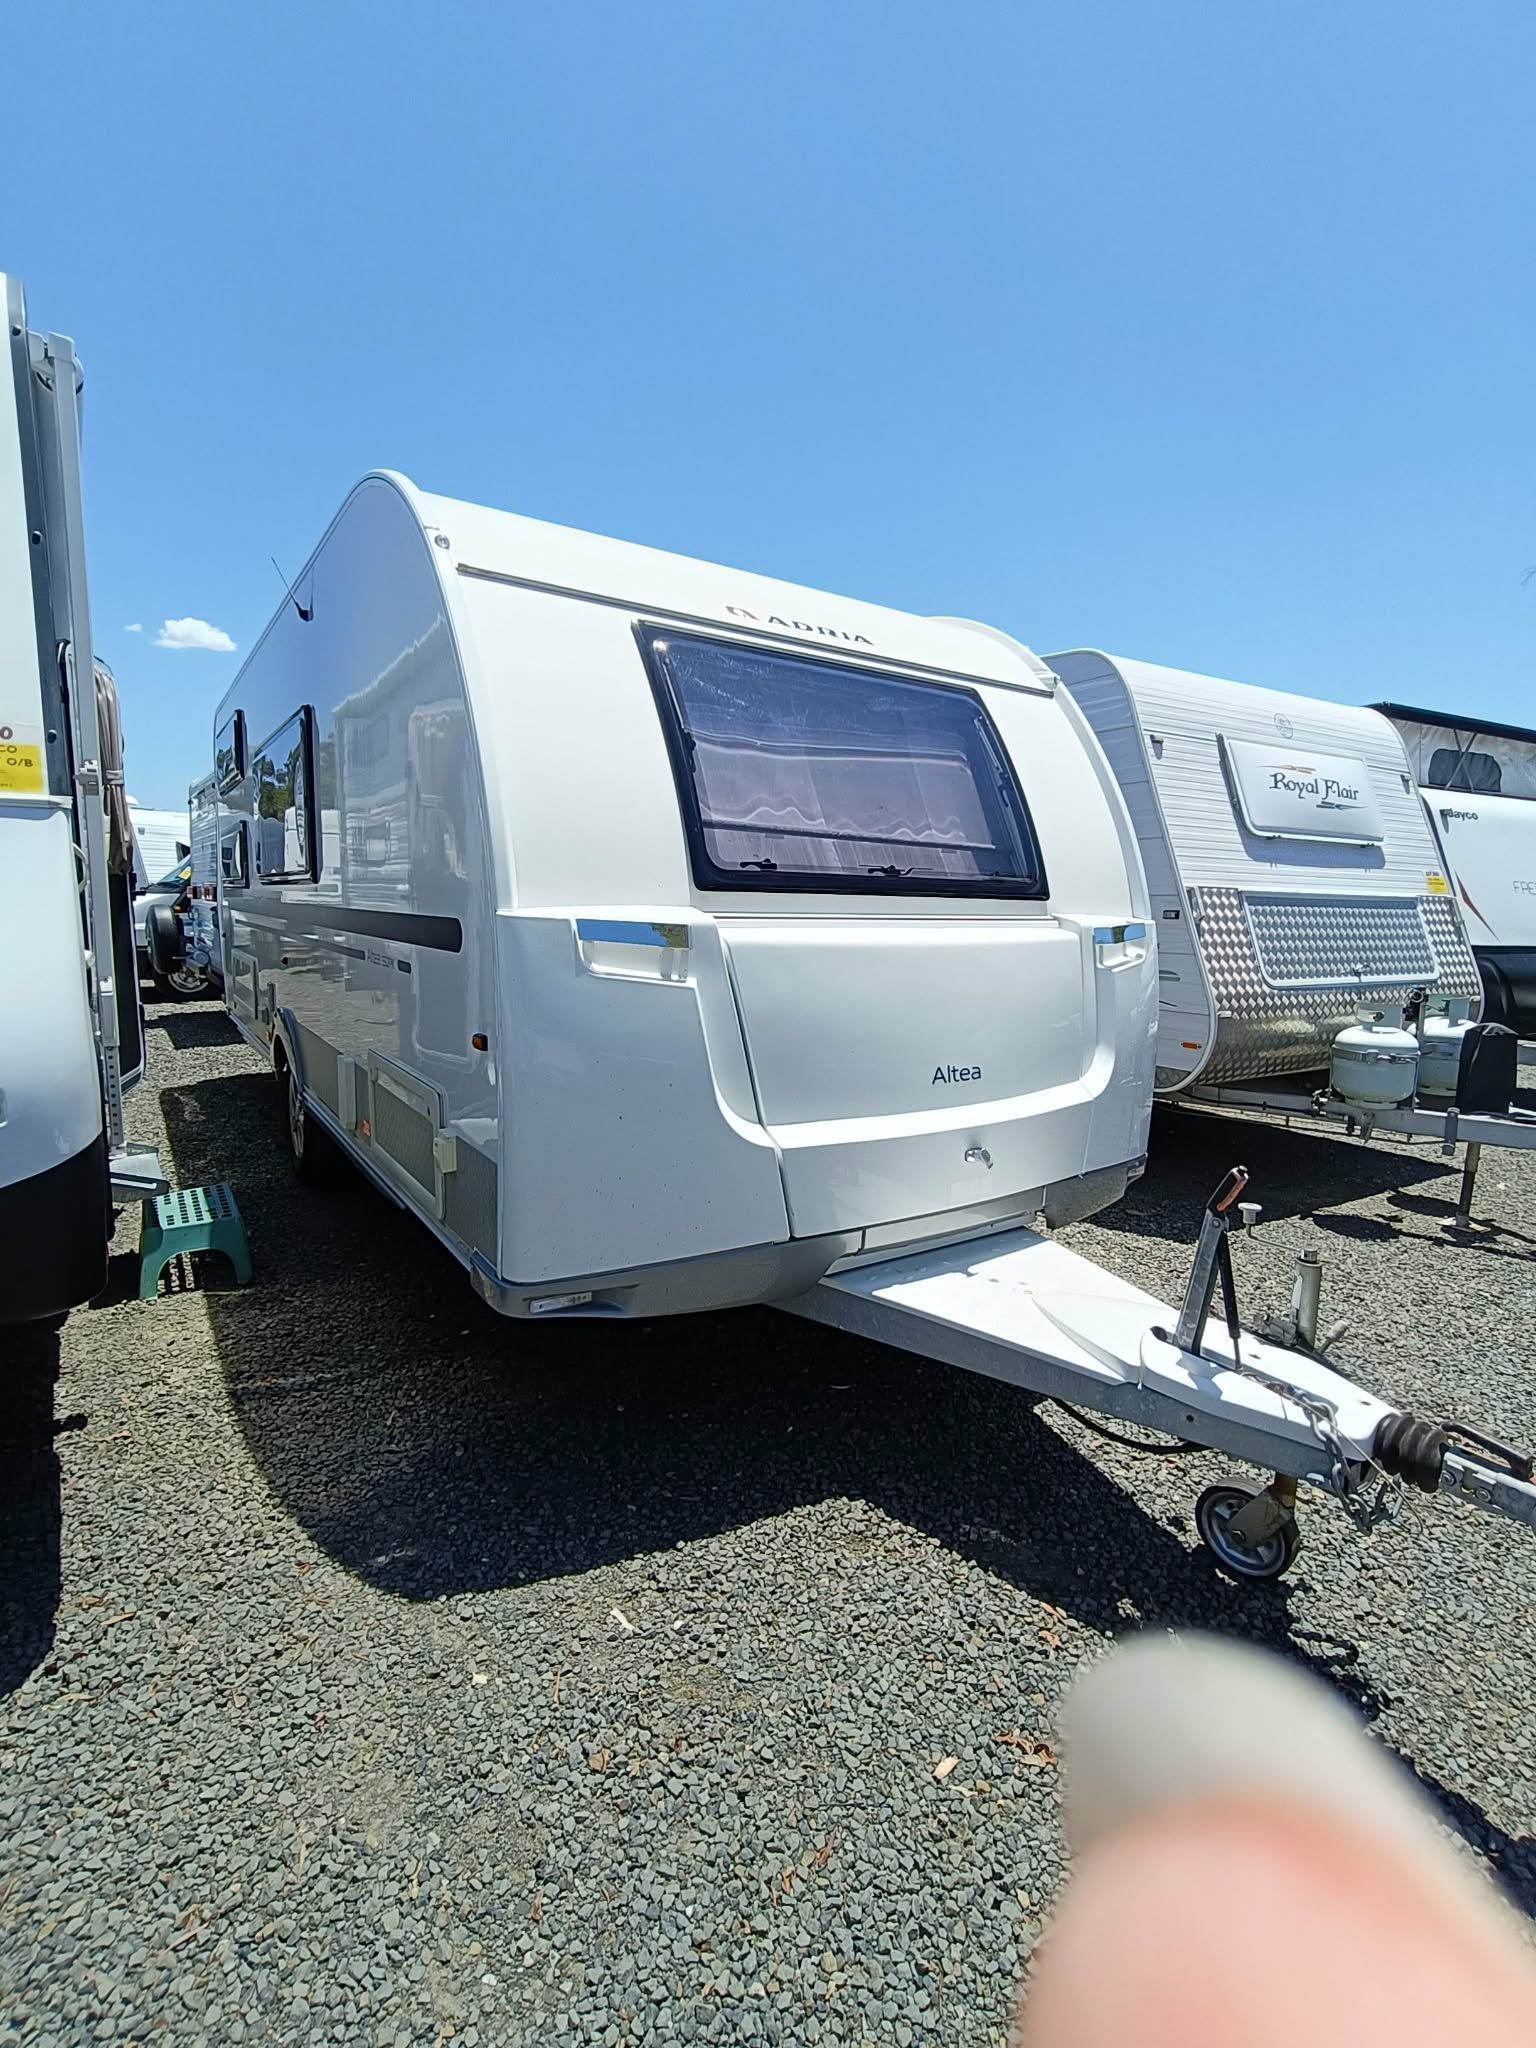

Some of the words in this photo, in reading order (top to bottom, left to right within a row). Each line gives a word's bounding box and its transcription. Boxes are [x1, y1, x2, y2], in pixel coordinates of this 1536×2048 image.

[768, 615, 874, 645] ADRIA
[1269, 772, 1319, 799] Royal
[1320, 778, 1359, 801] Flair
[932, 1065, 982, 1085] Altea
